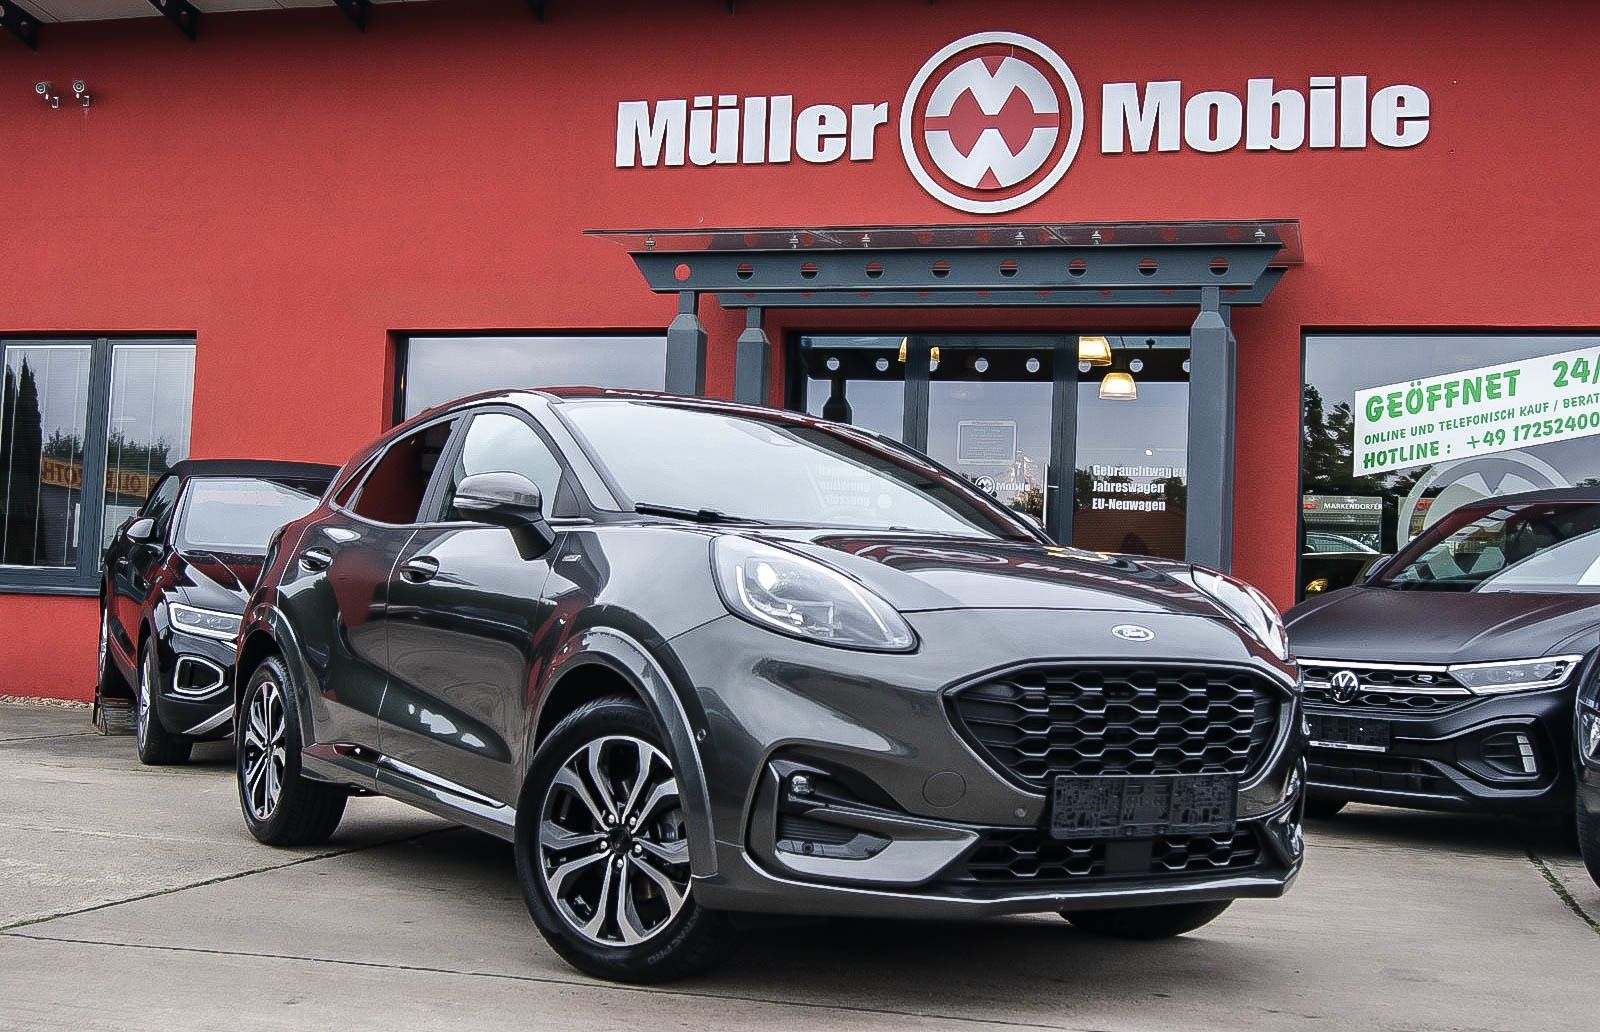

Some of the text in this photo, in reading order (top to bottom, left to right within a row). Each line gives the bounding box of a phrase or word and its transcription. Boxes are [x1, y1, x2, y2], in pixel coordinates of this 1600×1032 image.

[615, 75, 1431, 168] Müller Mobile
[1365, 368, 1521, 423] GEÖFFNET
[1362, 440, 1440, 470] HOTLINE
[1466, 428, 1506, 450] +49
[1512, 411, 1600, 443] 17252400
[1364, 428, 1406, 446] ONLINE
[1410, 424, 1435, 437] UND
[1439, 409, 1515, 432] TELEFONISCH
[1519, 402, 1549, 418] KAUF
[1092, 464, 1186, 479] Gebrauchtwagen
[1092, 480, 1166, 495] Jahreswagen
[1091, 497, 1167, 512] EU-Neuwagen
